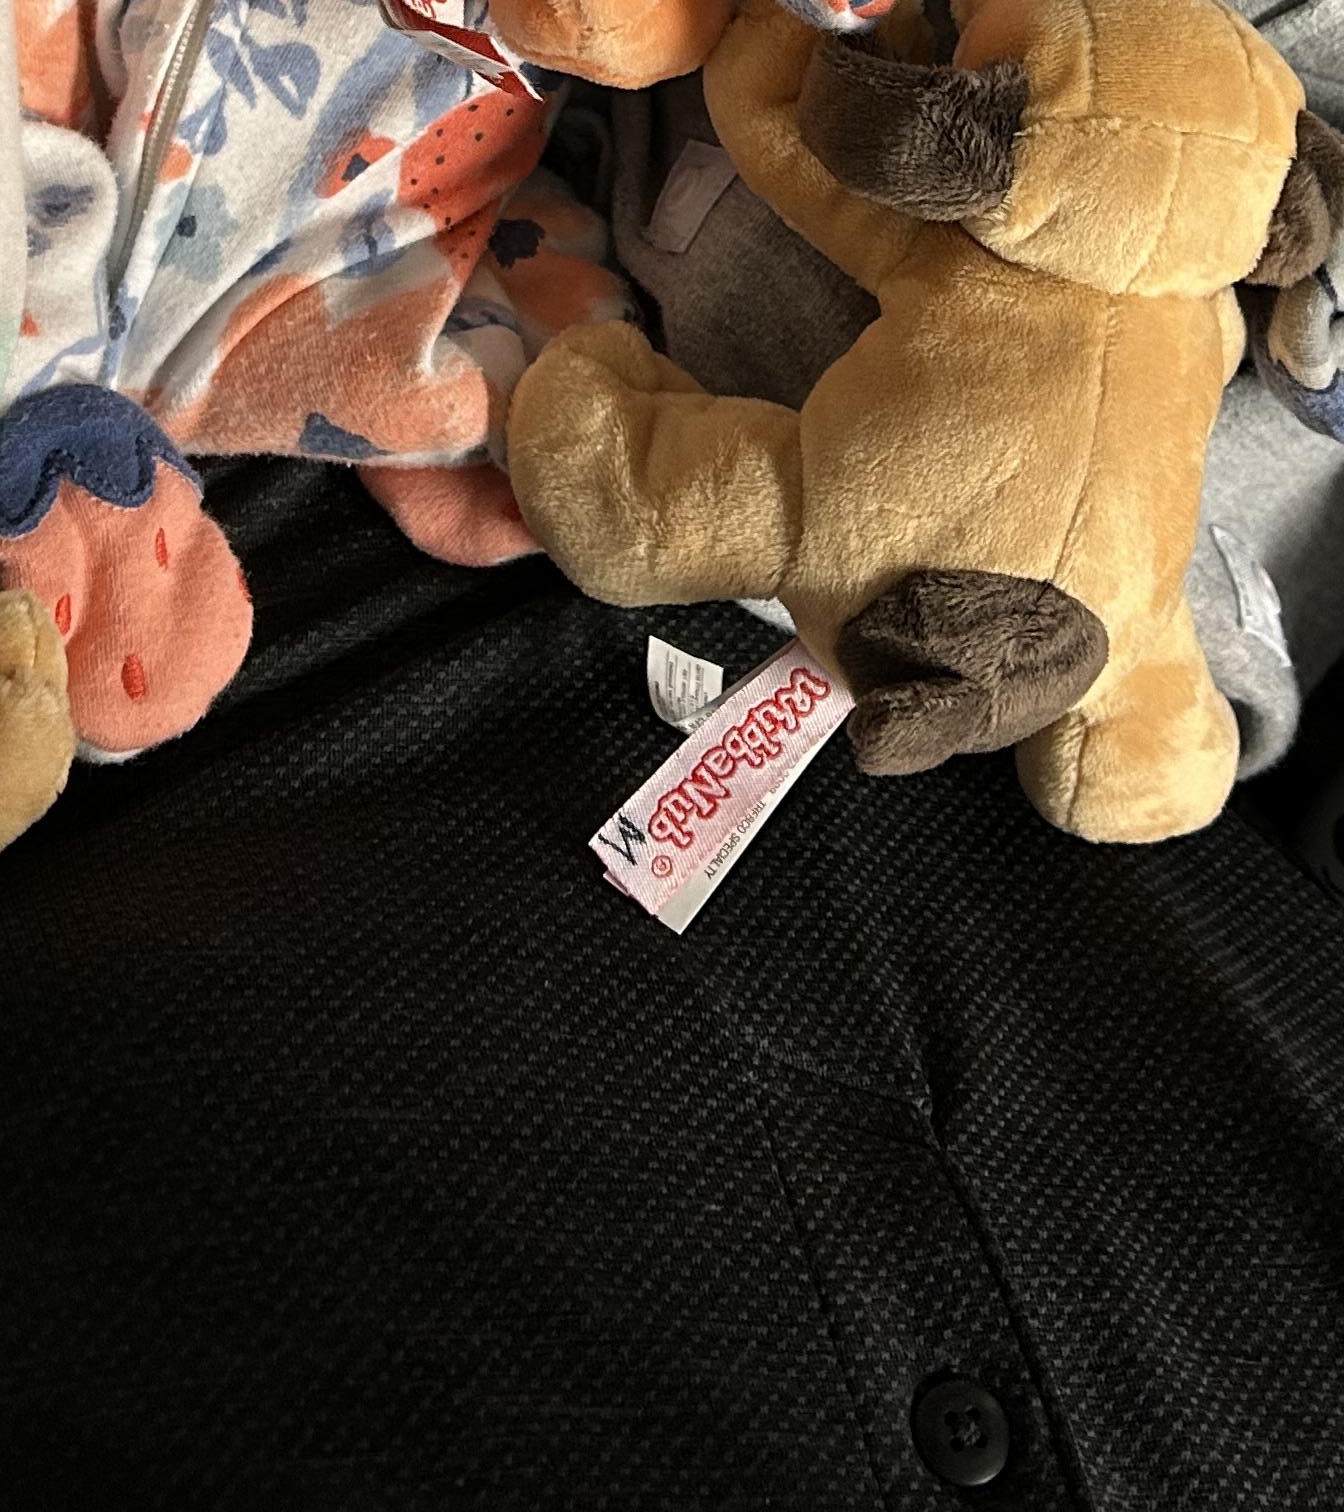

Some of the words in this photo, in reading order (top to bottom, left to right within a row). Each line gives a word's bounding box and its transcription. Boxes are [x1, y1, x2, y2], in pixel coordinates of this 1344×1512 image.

[648, 667, 830, 849] WubbaNub
[597, 813, 647, 866] M
[705, 832, 741, 881] SPECIALTY
